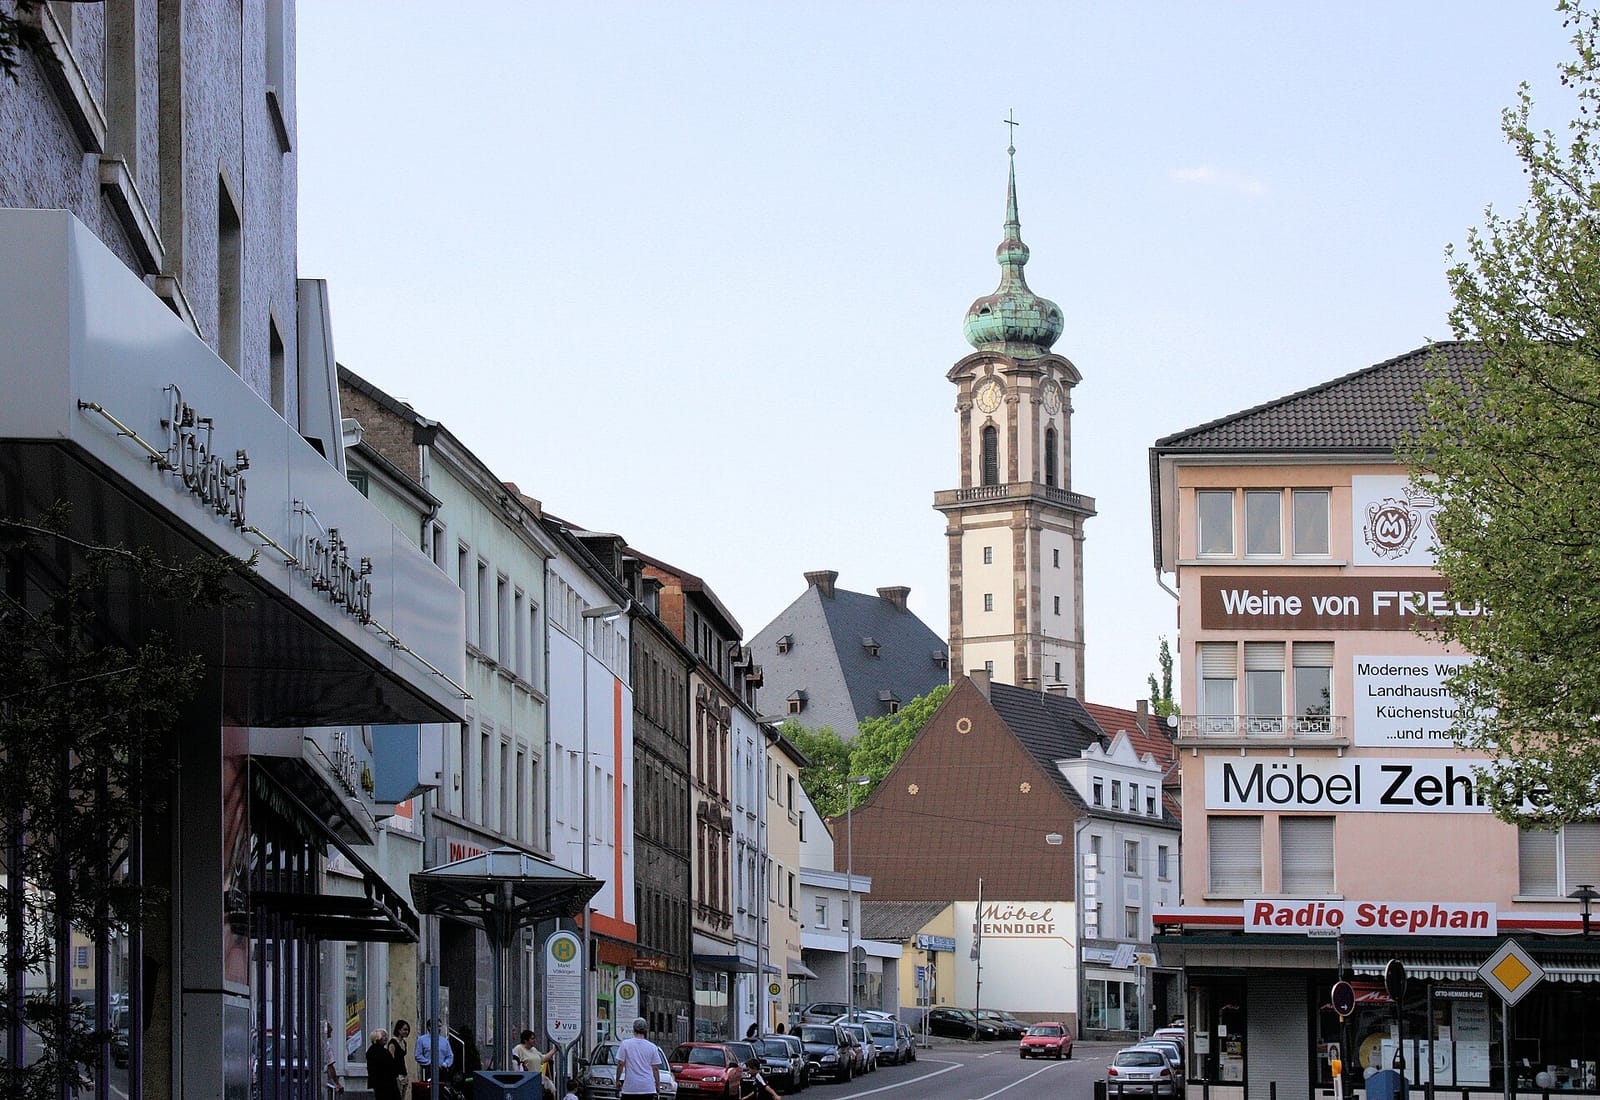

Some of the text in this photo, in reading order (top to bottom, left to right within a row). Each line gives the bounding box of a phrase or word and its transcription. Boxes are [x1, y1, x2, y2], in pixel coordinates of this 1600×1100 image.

[1220, 589, 1302, 616] Weine
[1311, 595, 1360, 616] von
[1357, 663, 1429, 677] Modernes
[1223, 762, 1361, 805] Möbel
[980, 903, 1054, 923] Möbel
[1252, 902, 1489, 933] Radio Stephan
